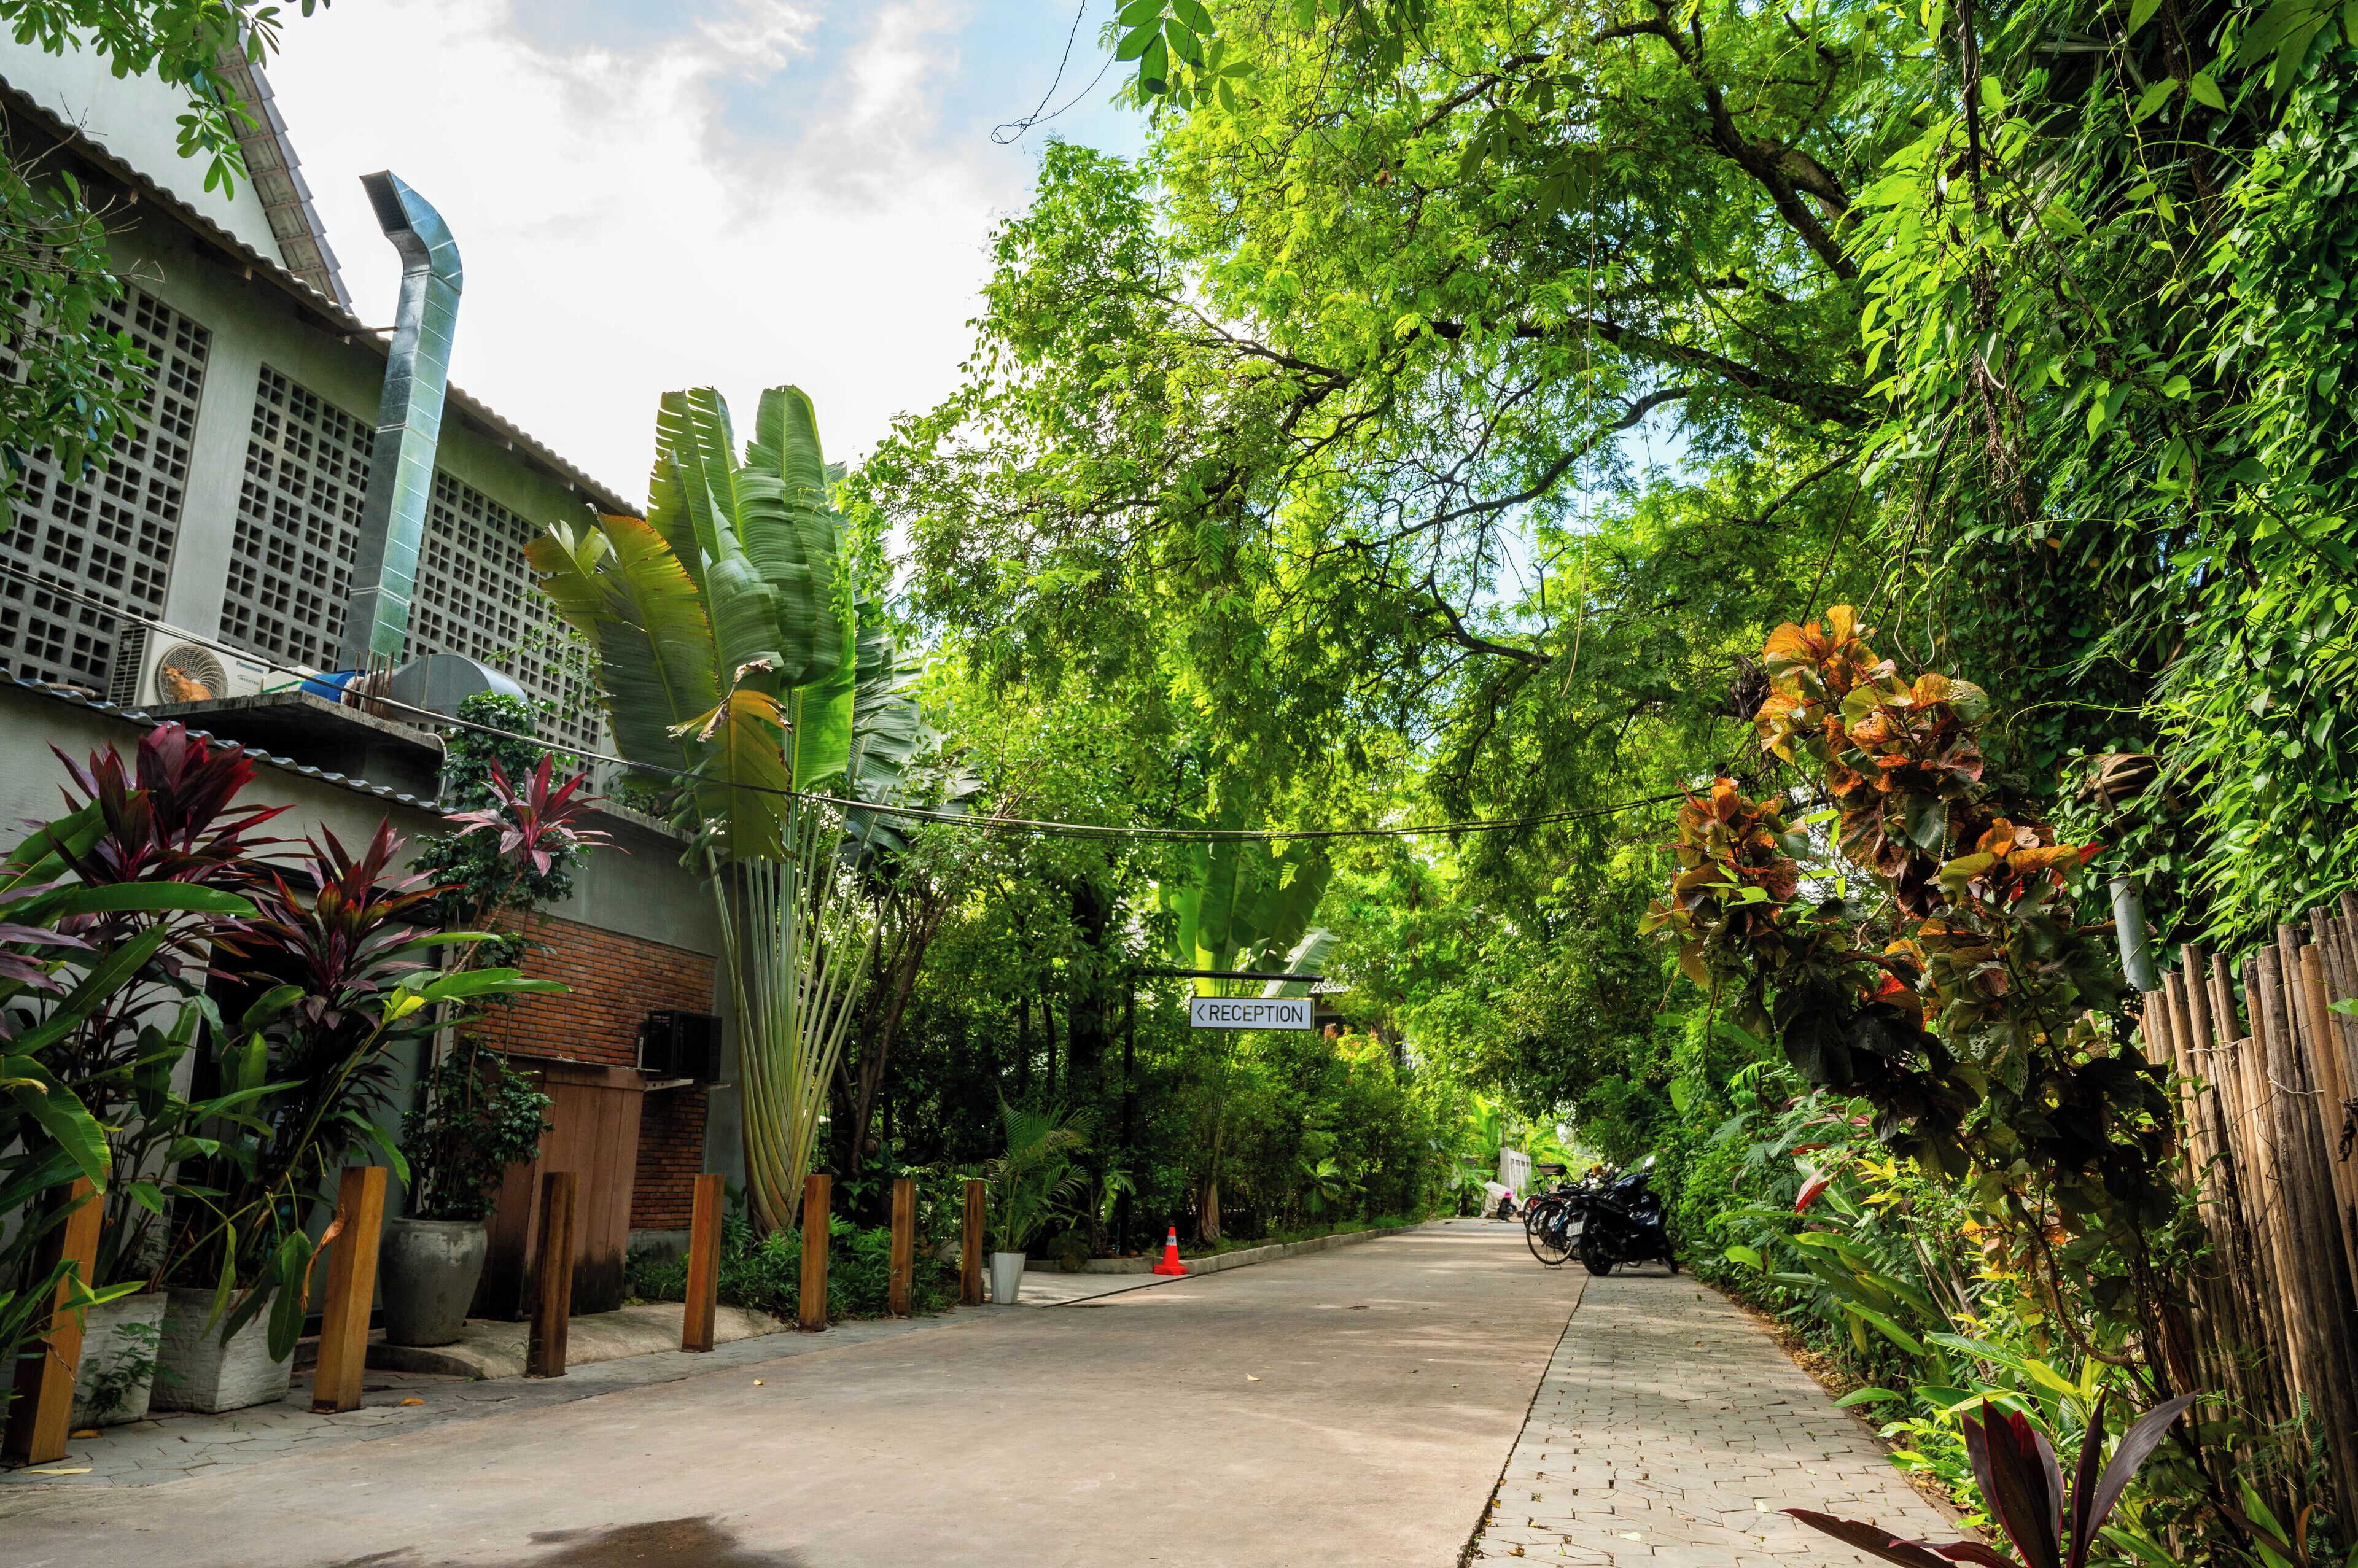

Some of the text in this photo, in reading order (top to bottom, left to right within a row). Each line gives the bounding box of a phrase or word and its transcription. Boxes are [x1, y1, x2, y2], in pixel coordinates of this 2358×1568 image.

[236, 661, 264, 673] Panasonic
[238, 675, 259, 685] INVERTER
[1210, 1005, 1302, 1022] RECEPTION
